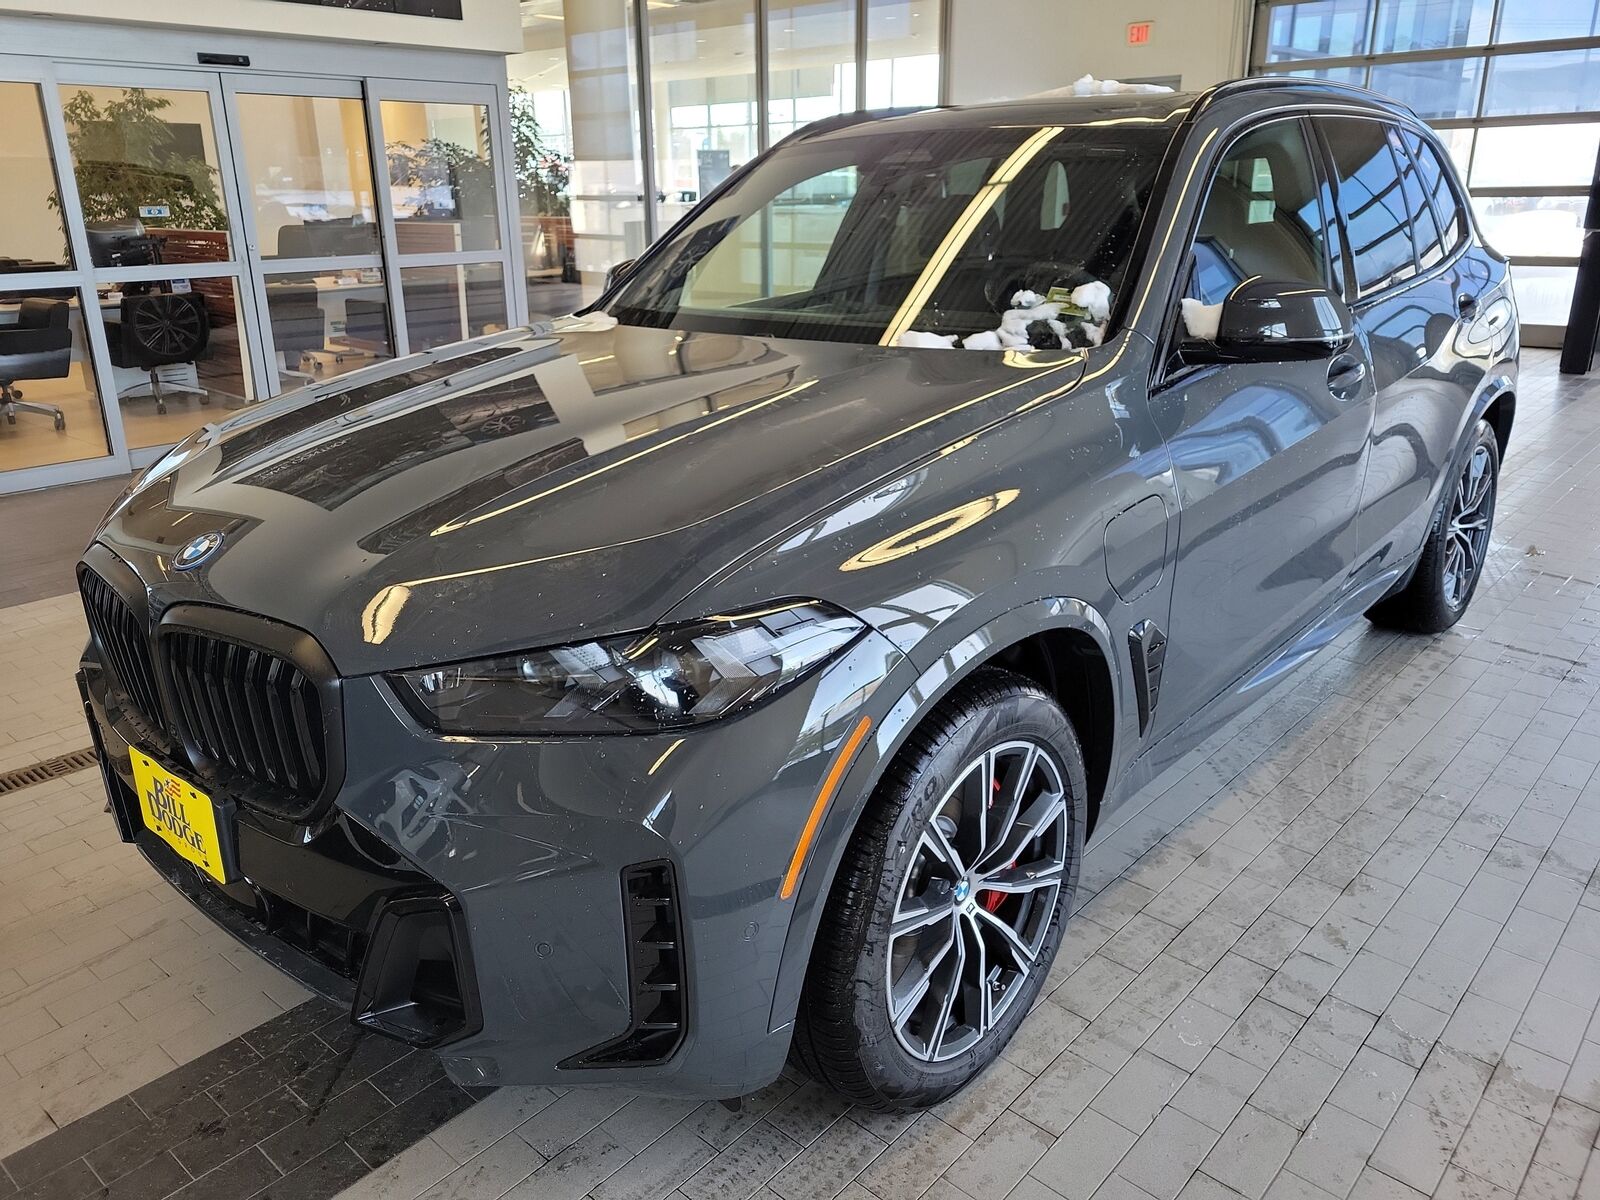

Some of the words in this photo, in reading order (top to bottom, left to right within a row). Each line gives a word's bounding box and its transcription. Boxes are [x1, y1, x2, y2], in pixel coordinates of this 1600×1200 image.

[1130, 25, 1149, 43] EXIT
[146, 789, 207, 855] DODGE
[152, 776, 191, 827] BILL
